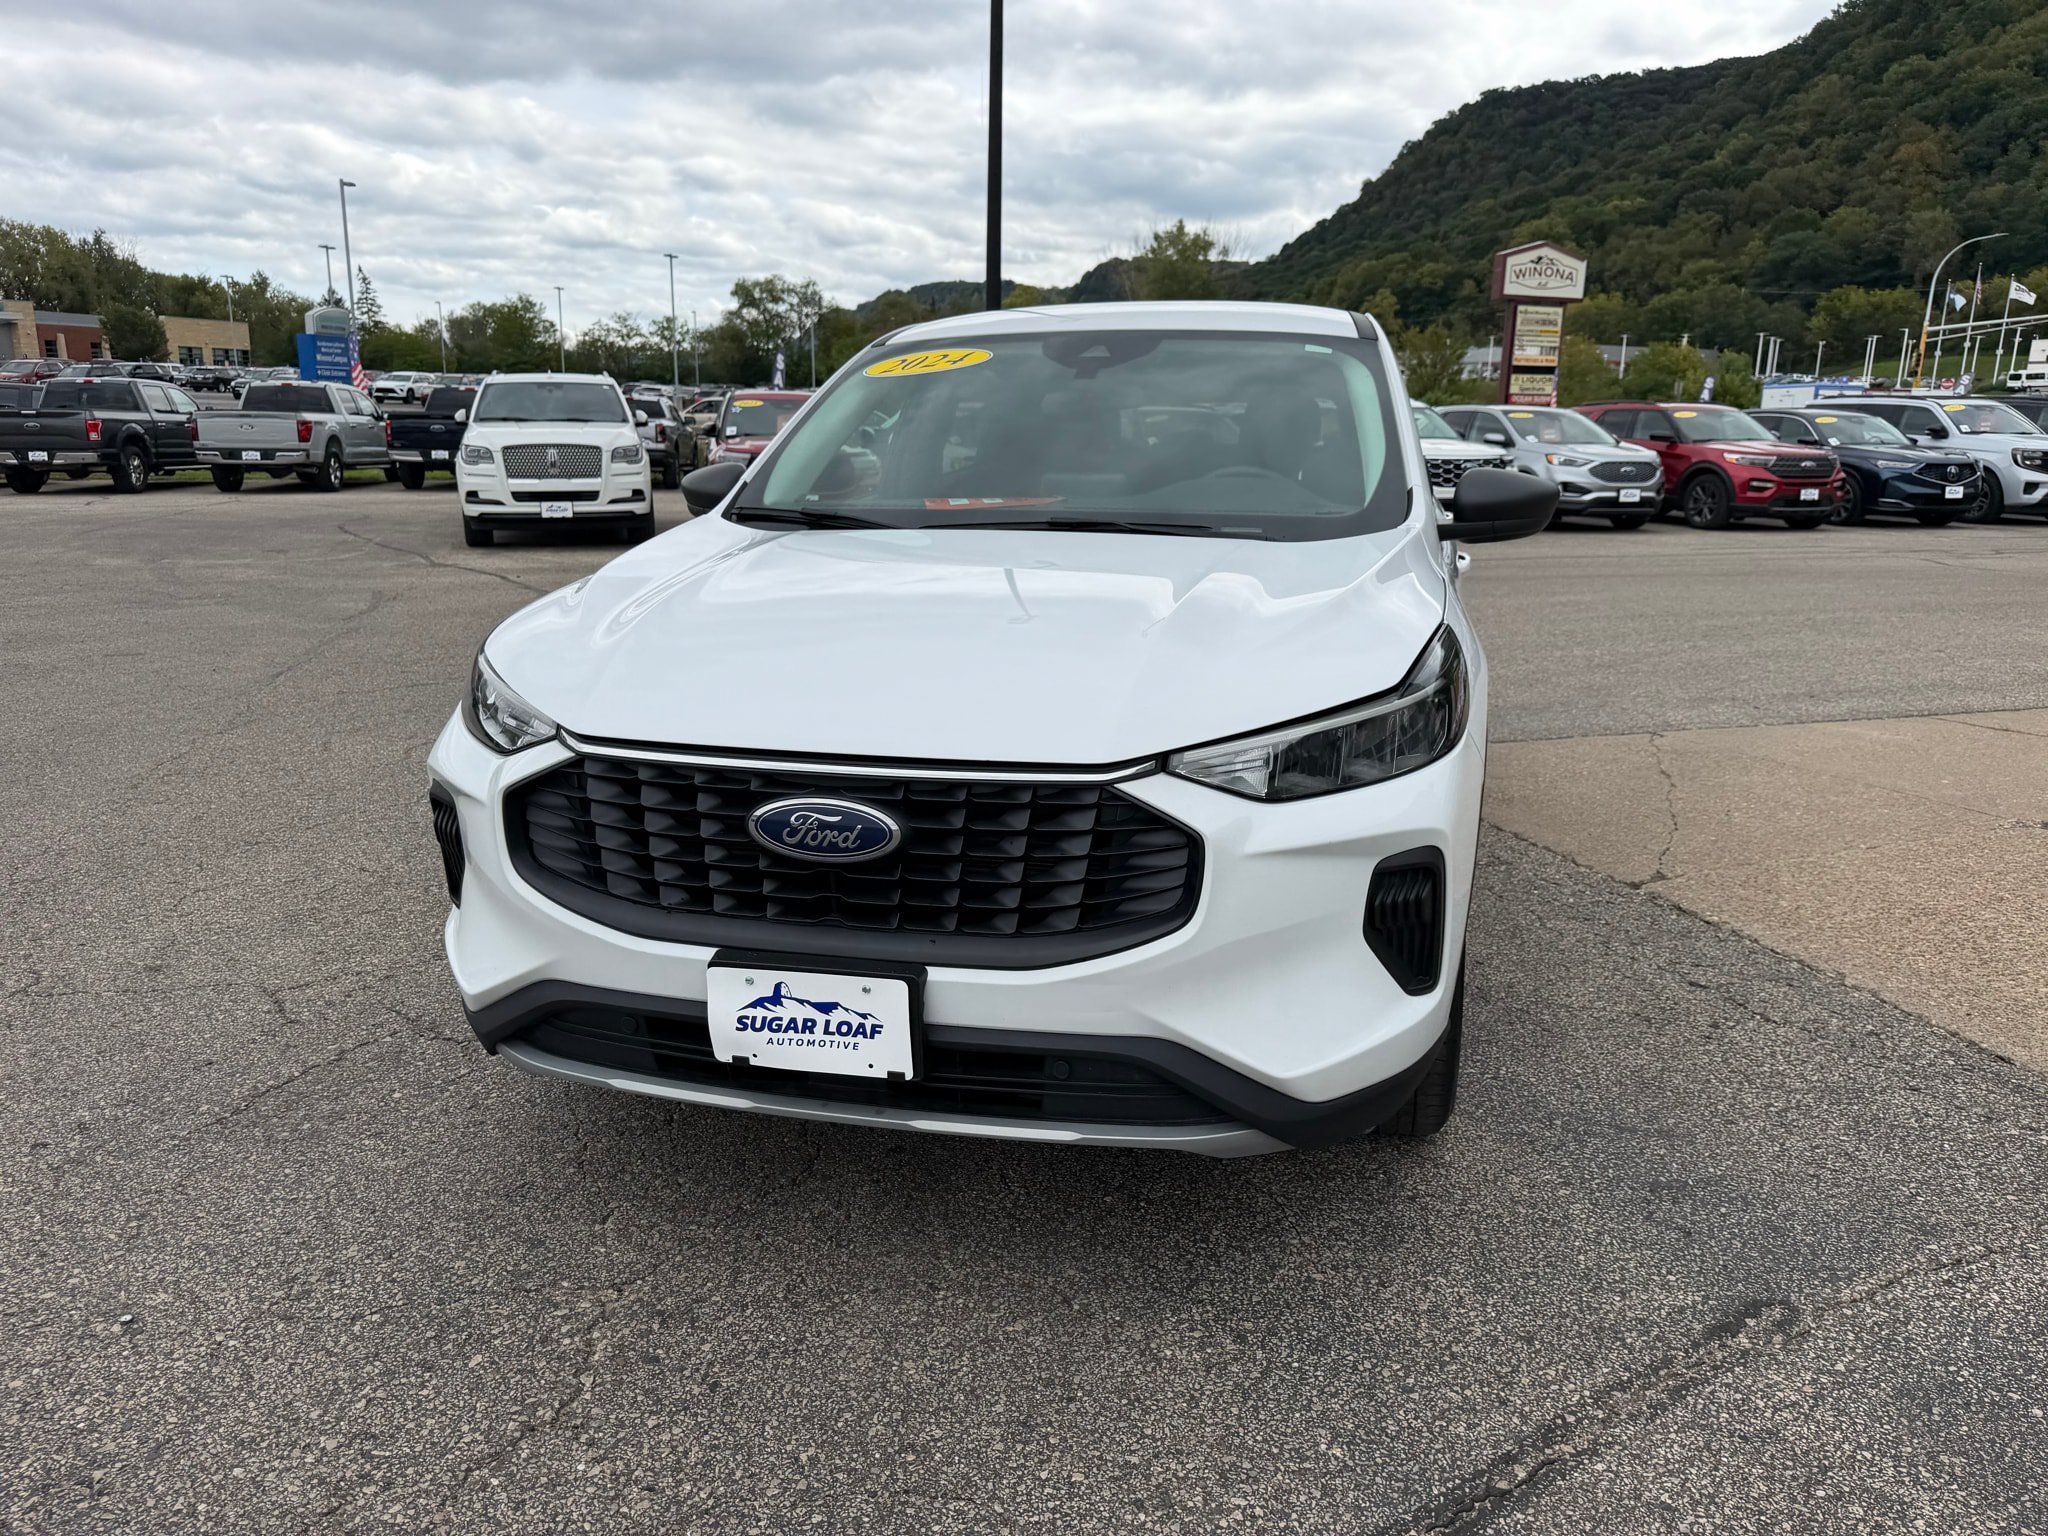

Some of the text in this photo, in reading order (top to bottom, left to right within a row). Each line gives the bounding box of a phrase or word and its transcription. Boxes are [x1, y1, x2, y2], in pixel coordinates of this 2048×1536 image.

[1513, 266, 1575, 284] WINONA
[878, 351, 976, 374] 2024
[1521, 376, 1552, 385] LIQUOR
[782, 811, 862, 849] Ford
[735, 1014, 884, 1040] SUGAR LOAF
[766, 1037, 860, 1051] AUTOMOTIVE
